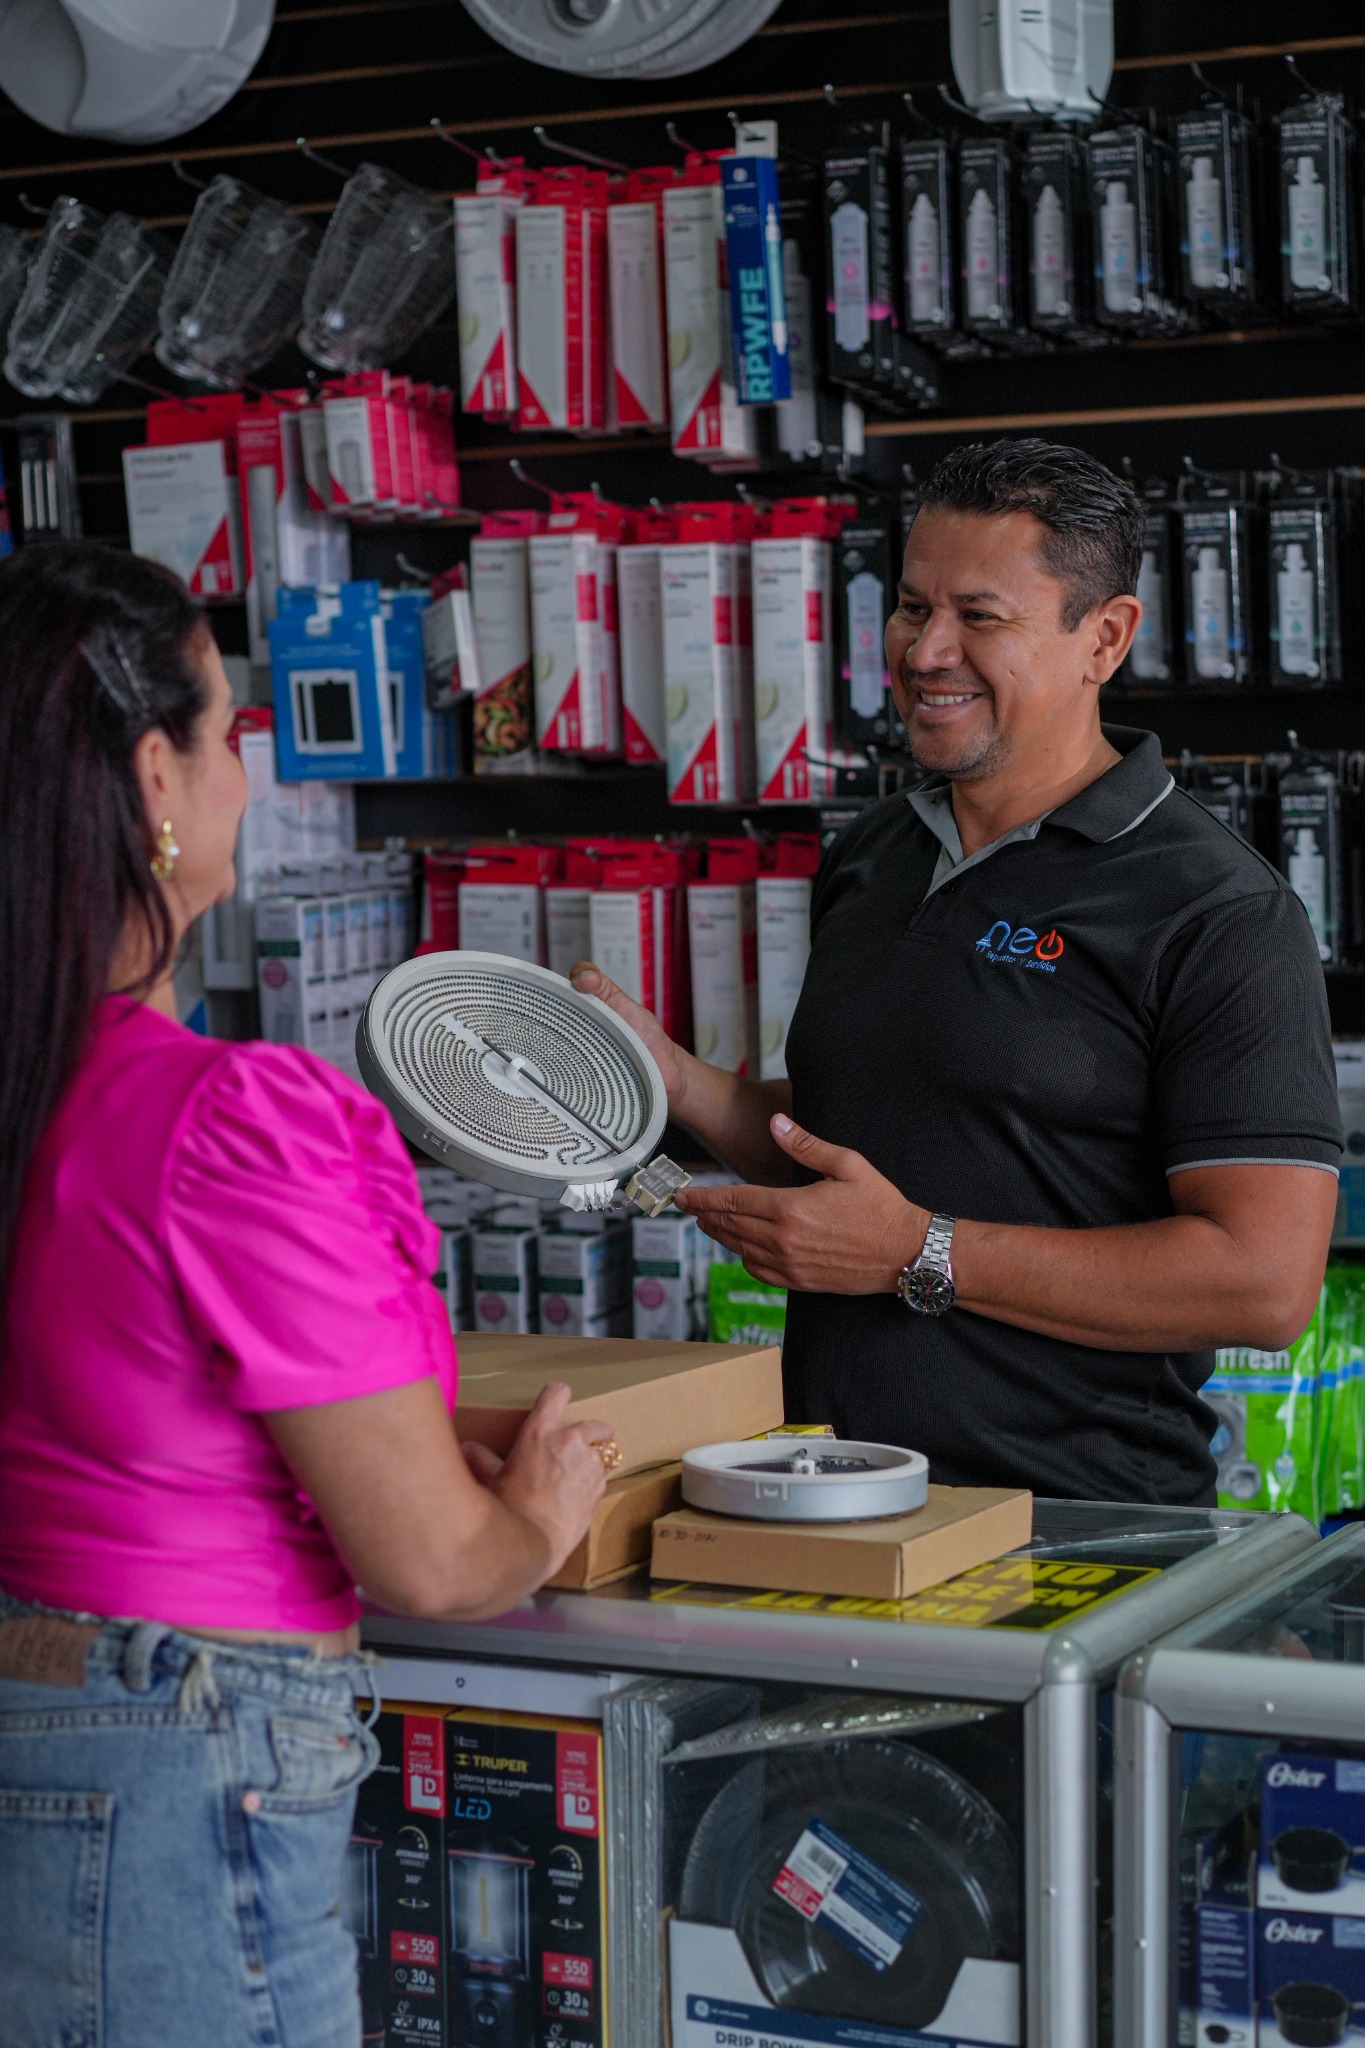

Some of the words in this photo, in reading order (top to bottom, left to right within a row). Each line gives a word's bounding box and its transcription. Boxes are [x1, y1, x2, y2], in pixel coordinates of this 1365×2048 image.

[739, 267, 773, 400] RPWFE
[976, 920, 1064, 960] neo
[994, 1562, 1117, 1585] NO
[1012, 1587, 1099, 1608] EN
[471, 1754, 528, 1774] TRUPER
[1267, 1761, 1327, 1789] Oster
[424, 1776, 437, 1794] D
[454, 1796, 492, 1821] LED
[577, 1796, 591, 1813] D
[1265, 1917, 1324, 1945] Oster
[411, 1937, 435, 1954] 550
[411, 1968, 428, 1985] 30
[564, 1959, 589, 1977] 550
[563, 1990, 581, 2007] 30
[417, 2016, 441, 2032] IPX4
[715, 2031, 754, 2048] DRIP
